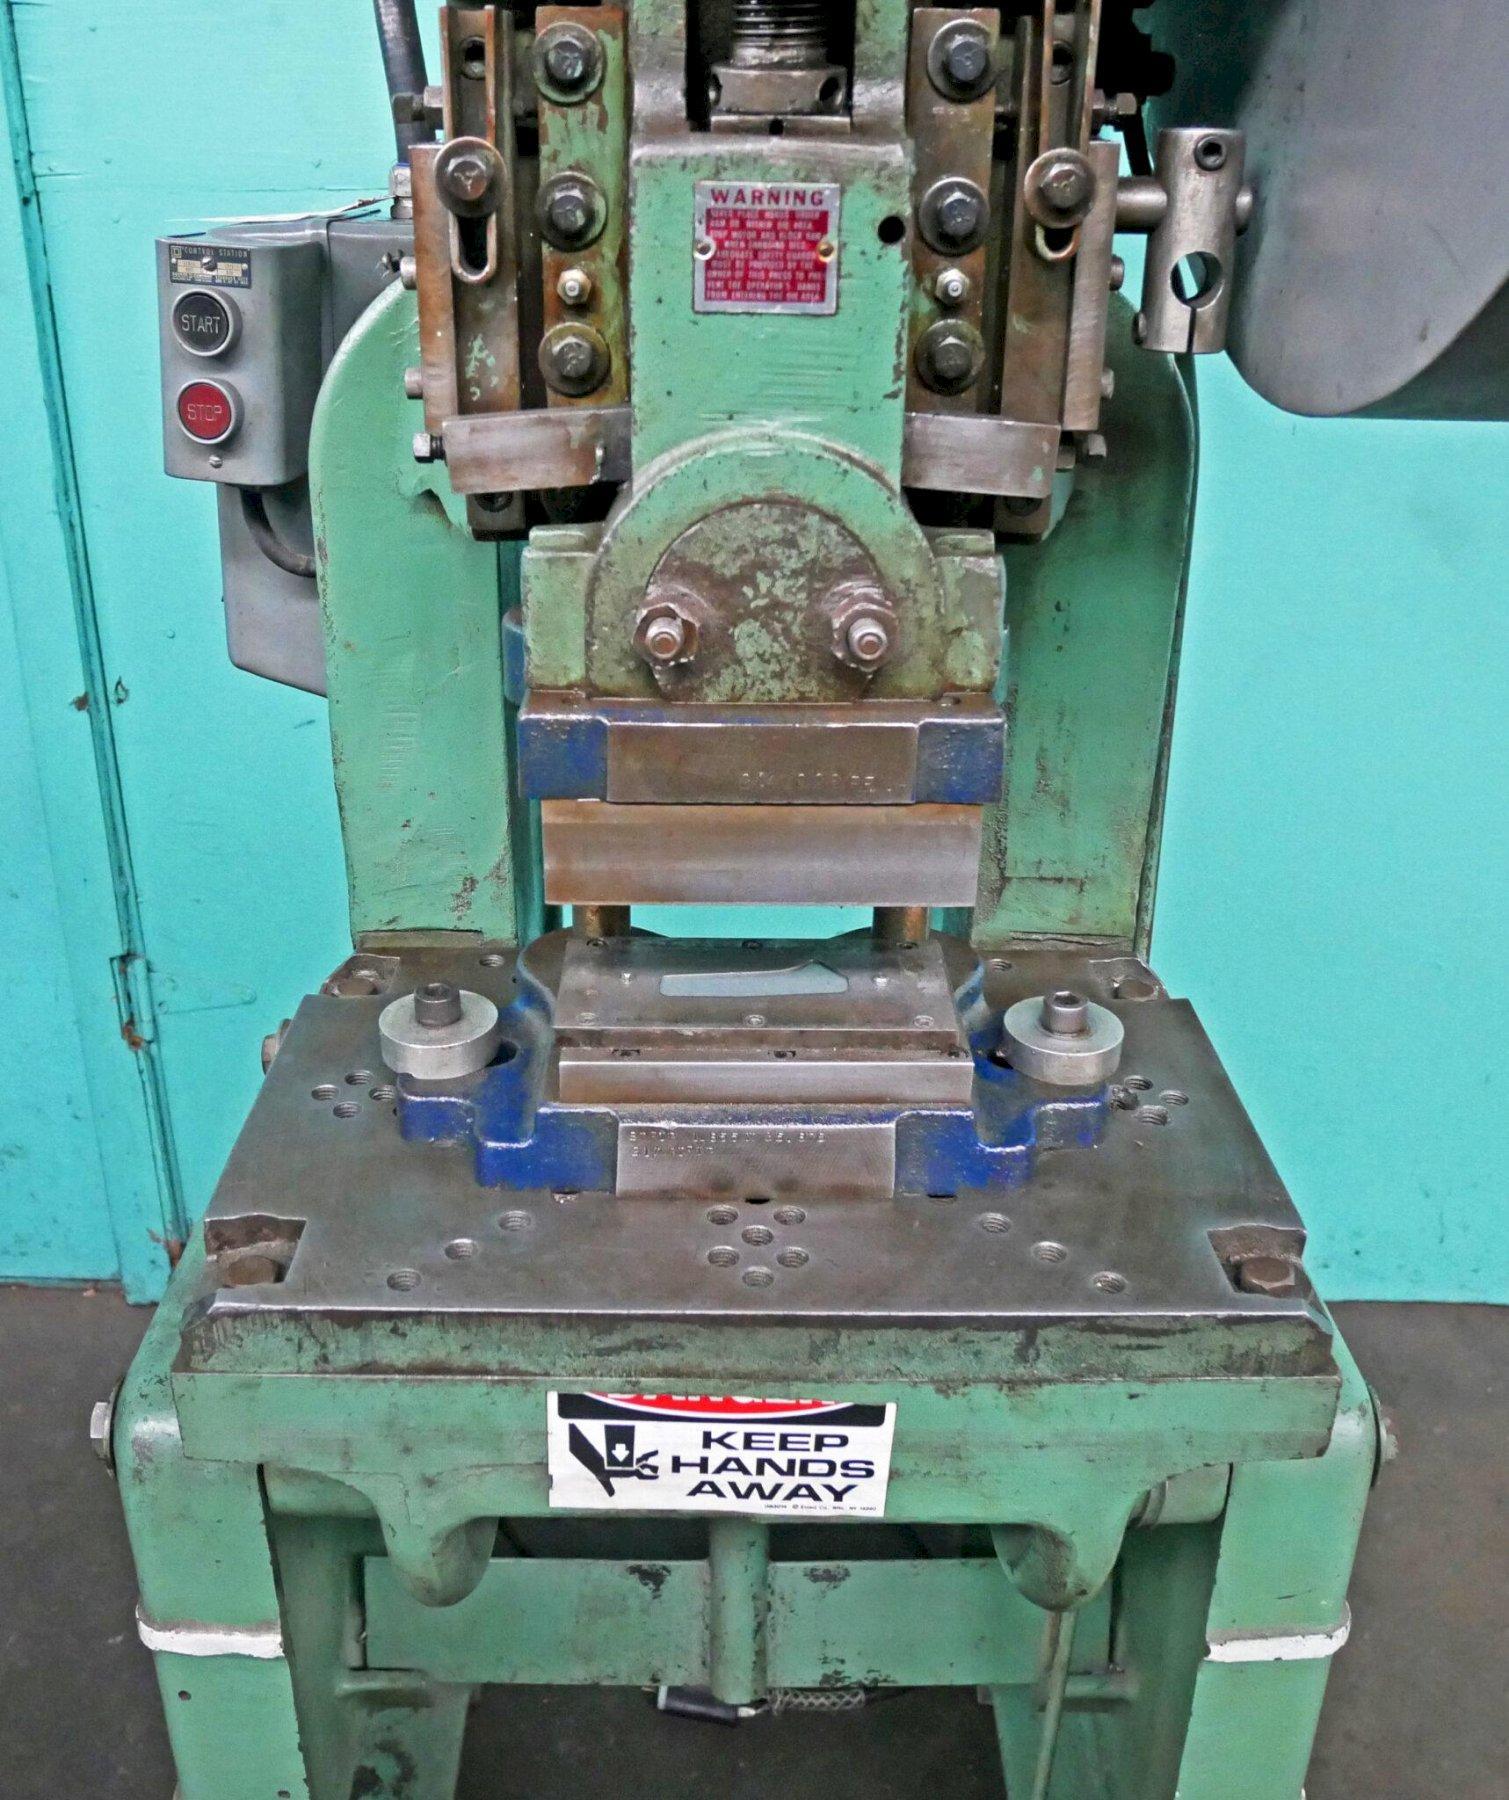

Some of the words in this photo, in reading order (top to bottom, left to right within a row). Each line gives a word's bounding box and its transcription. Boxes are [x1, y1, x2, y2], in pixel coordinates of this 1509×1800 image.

[711, 189, 823, 206] WARNING
[219, 249, 248, 258] STATION
[181, 314, 220, 335] START
[187, 403, 222, 421] STOP
[702, 1430, 849, 1452] KEEP
[671, 1455, 875, 1479] HANDS
[686, 1480, 858, 1502] AWAY
